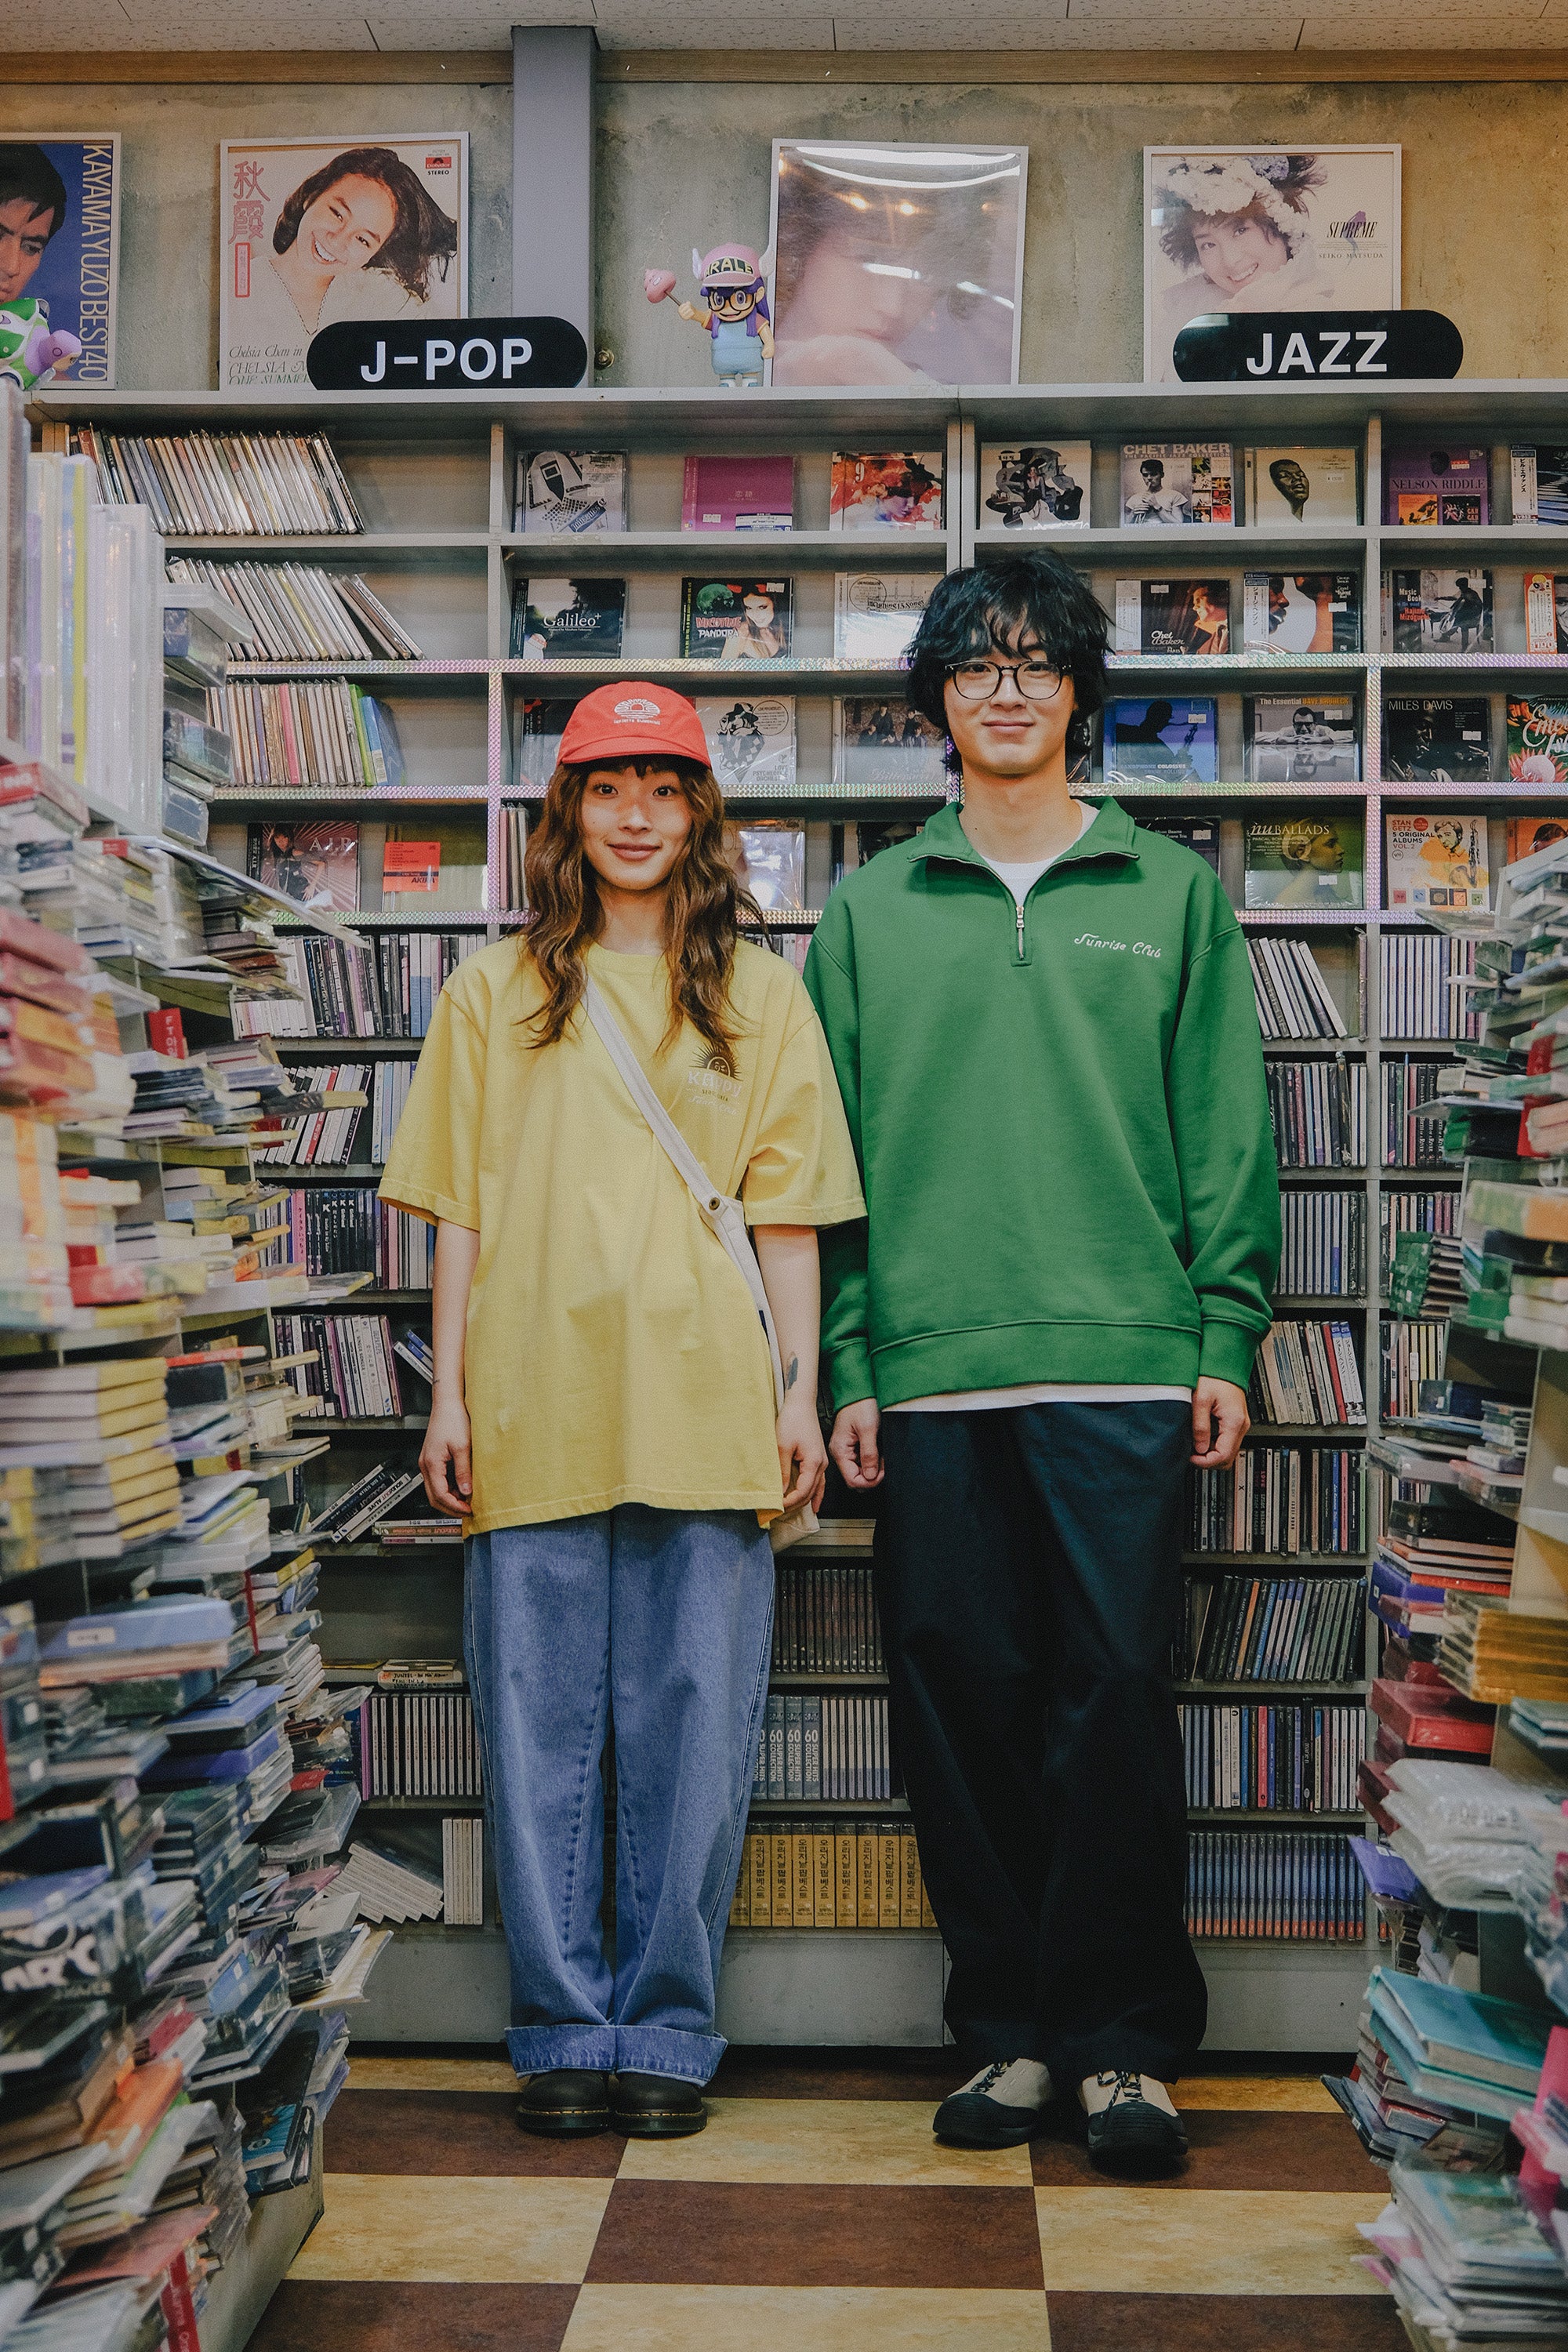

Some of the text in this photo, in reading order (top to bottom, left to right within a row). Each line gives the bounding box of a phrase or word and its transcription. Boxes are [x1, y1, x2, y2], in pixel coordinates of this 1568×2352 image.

[82, 144, 112, 237] KAYAMA
[1327, 222, 1377, 238] SUPREME
[80, 238, 110, 296] YUZO
[229, 344, 302, 358] Chelsia Chan in
[1247, 332, 1388, 376] JAZZ
[361, 338, 532, 383] J-POP
[1123, 443, 1230, 454] CHET BAKER
[855, 462, 865, 482] 9
[1392, 479, 1486, 489] NELSON RIDDLE
[698, 629, 739, 638] PANDORA
[1151, 630, 1174, 640] Chet
[1388, 700, 1454, 710] MILES DAVIS
[1074, 933, 1162, 958] Sunrise Club
[322, 1203, 331, 1213] K
[769, 1730, 782, 1743] 60
[787, 1730, 800, 1743] 60
[804, 1730, 818, 1743] 60
